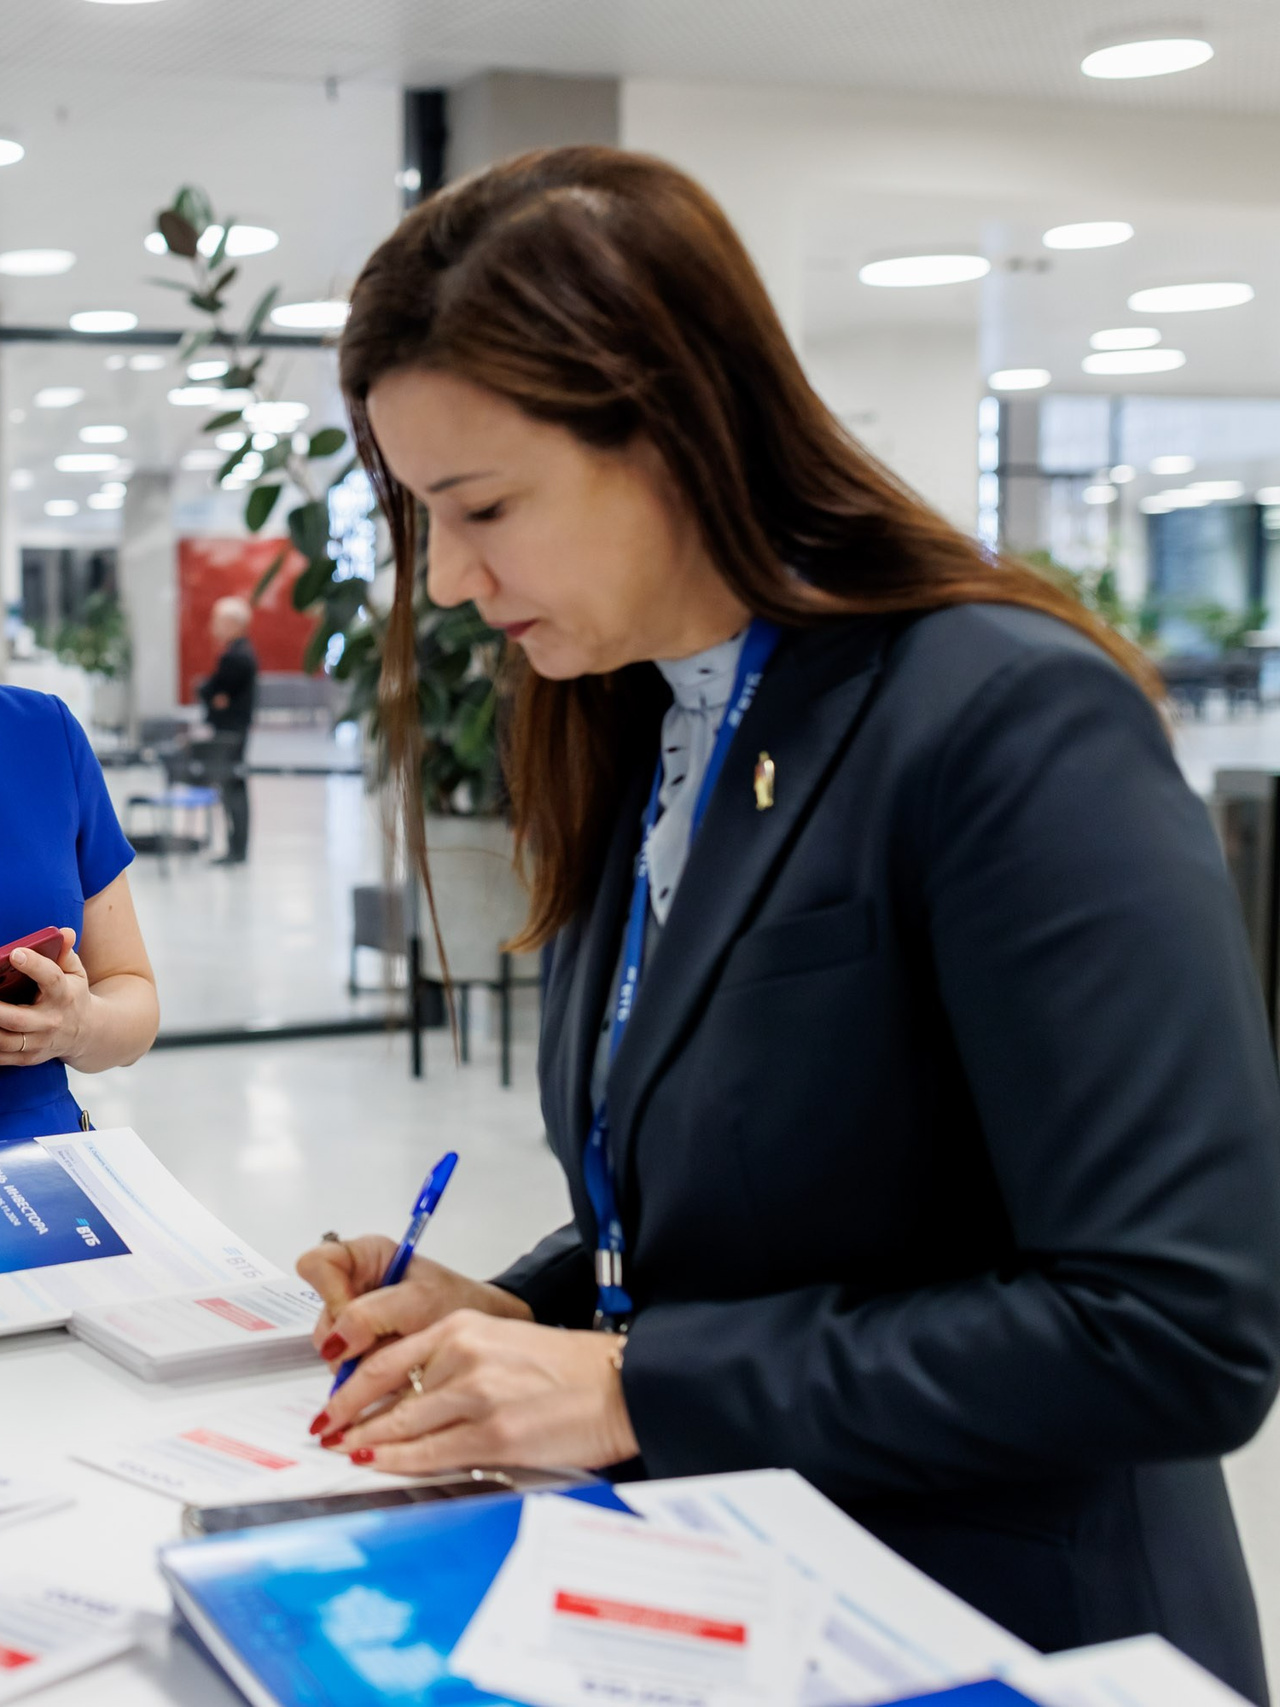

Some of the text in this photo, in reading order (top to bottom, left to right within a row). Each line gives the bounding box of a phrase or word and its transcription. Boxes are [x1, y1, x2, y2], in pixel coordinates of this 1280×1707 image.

[3, 1185, 49, 1235] ИНВЕСТОРА
[75, 1226, 101, 1248] ВТБ
[225, 1256, 264, 1279] ВТБ
